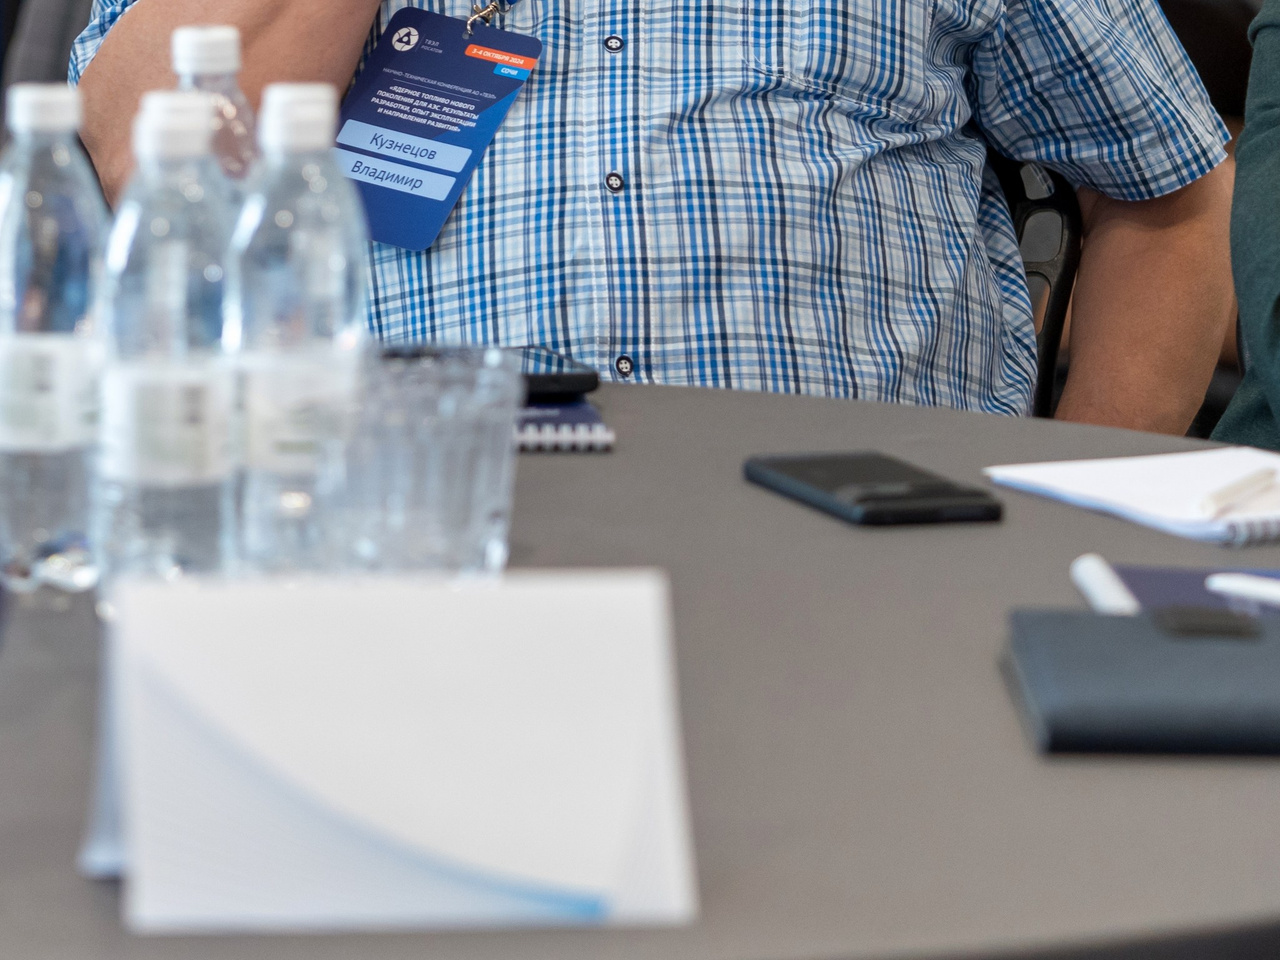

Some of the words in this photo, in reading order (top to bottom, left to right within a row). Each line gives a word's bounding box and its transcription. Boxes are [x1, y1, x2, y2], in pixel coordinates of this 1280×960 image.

[483, 51, 510, 61] ОКТЯБРЯ
[509, 56, 524, 65] 2024
[501, 67, 518, 76] СОЧИ
[377, 90, 414, 104] ПОКОЛЕНИЯ
[442, 106, 479, 120] РЕЗУЛЬТАТЫ
[421, 93, 450, 104] ТОПЛИВО
[450, 100, 475, 110] НОВОГО
[383, 109, 428, 124] НАПРАВЛЕНИЯ
[412, 108, 430, 116] ОПЫТ
[430, 112, 476, 127] ЭКСПЛУАТАЦИИ
[370, 133, 437, 160] Кузнецов
[351, 161, 423, 190] Владимир
